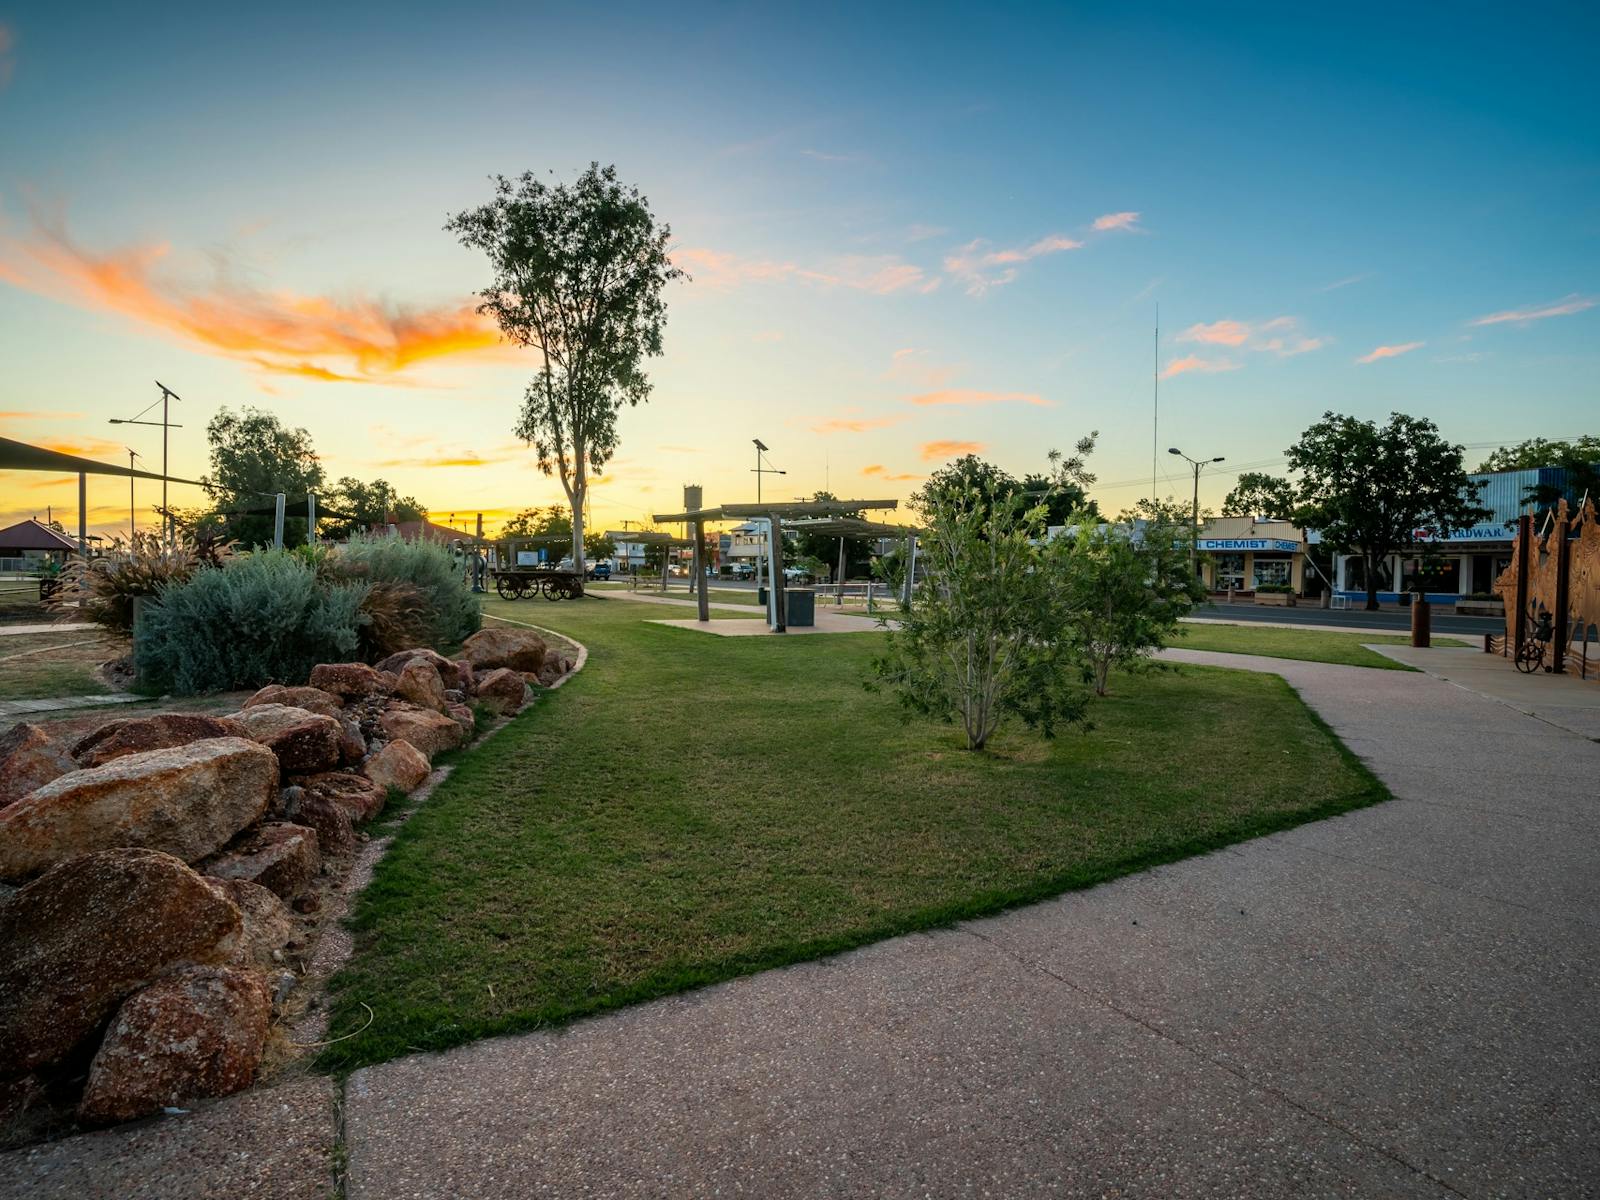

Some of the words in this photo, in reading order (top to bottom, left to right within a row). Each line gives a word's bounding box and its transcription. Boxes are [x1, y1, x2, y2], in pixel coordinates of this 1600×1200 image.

[1440, 527, 1504, 539] ARDWAR
[1206, 540, 1267, 549] CHEMIST
[1275, 541, 1298, 551] CHEMIST
